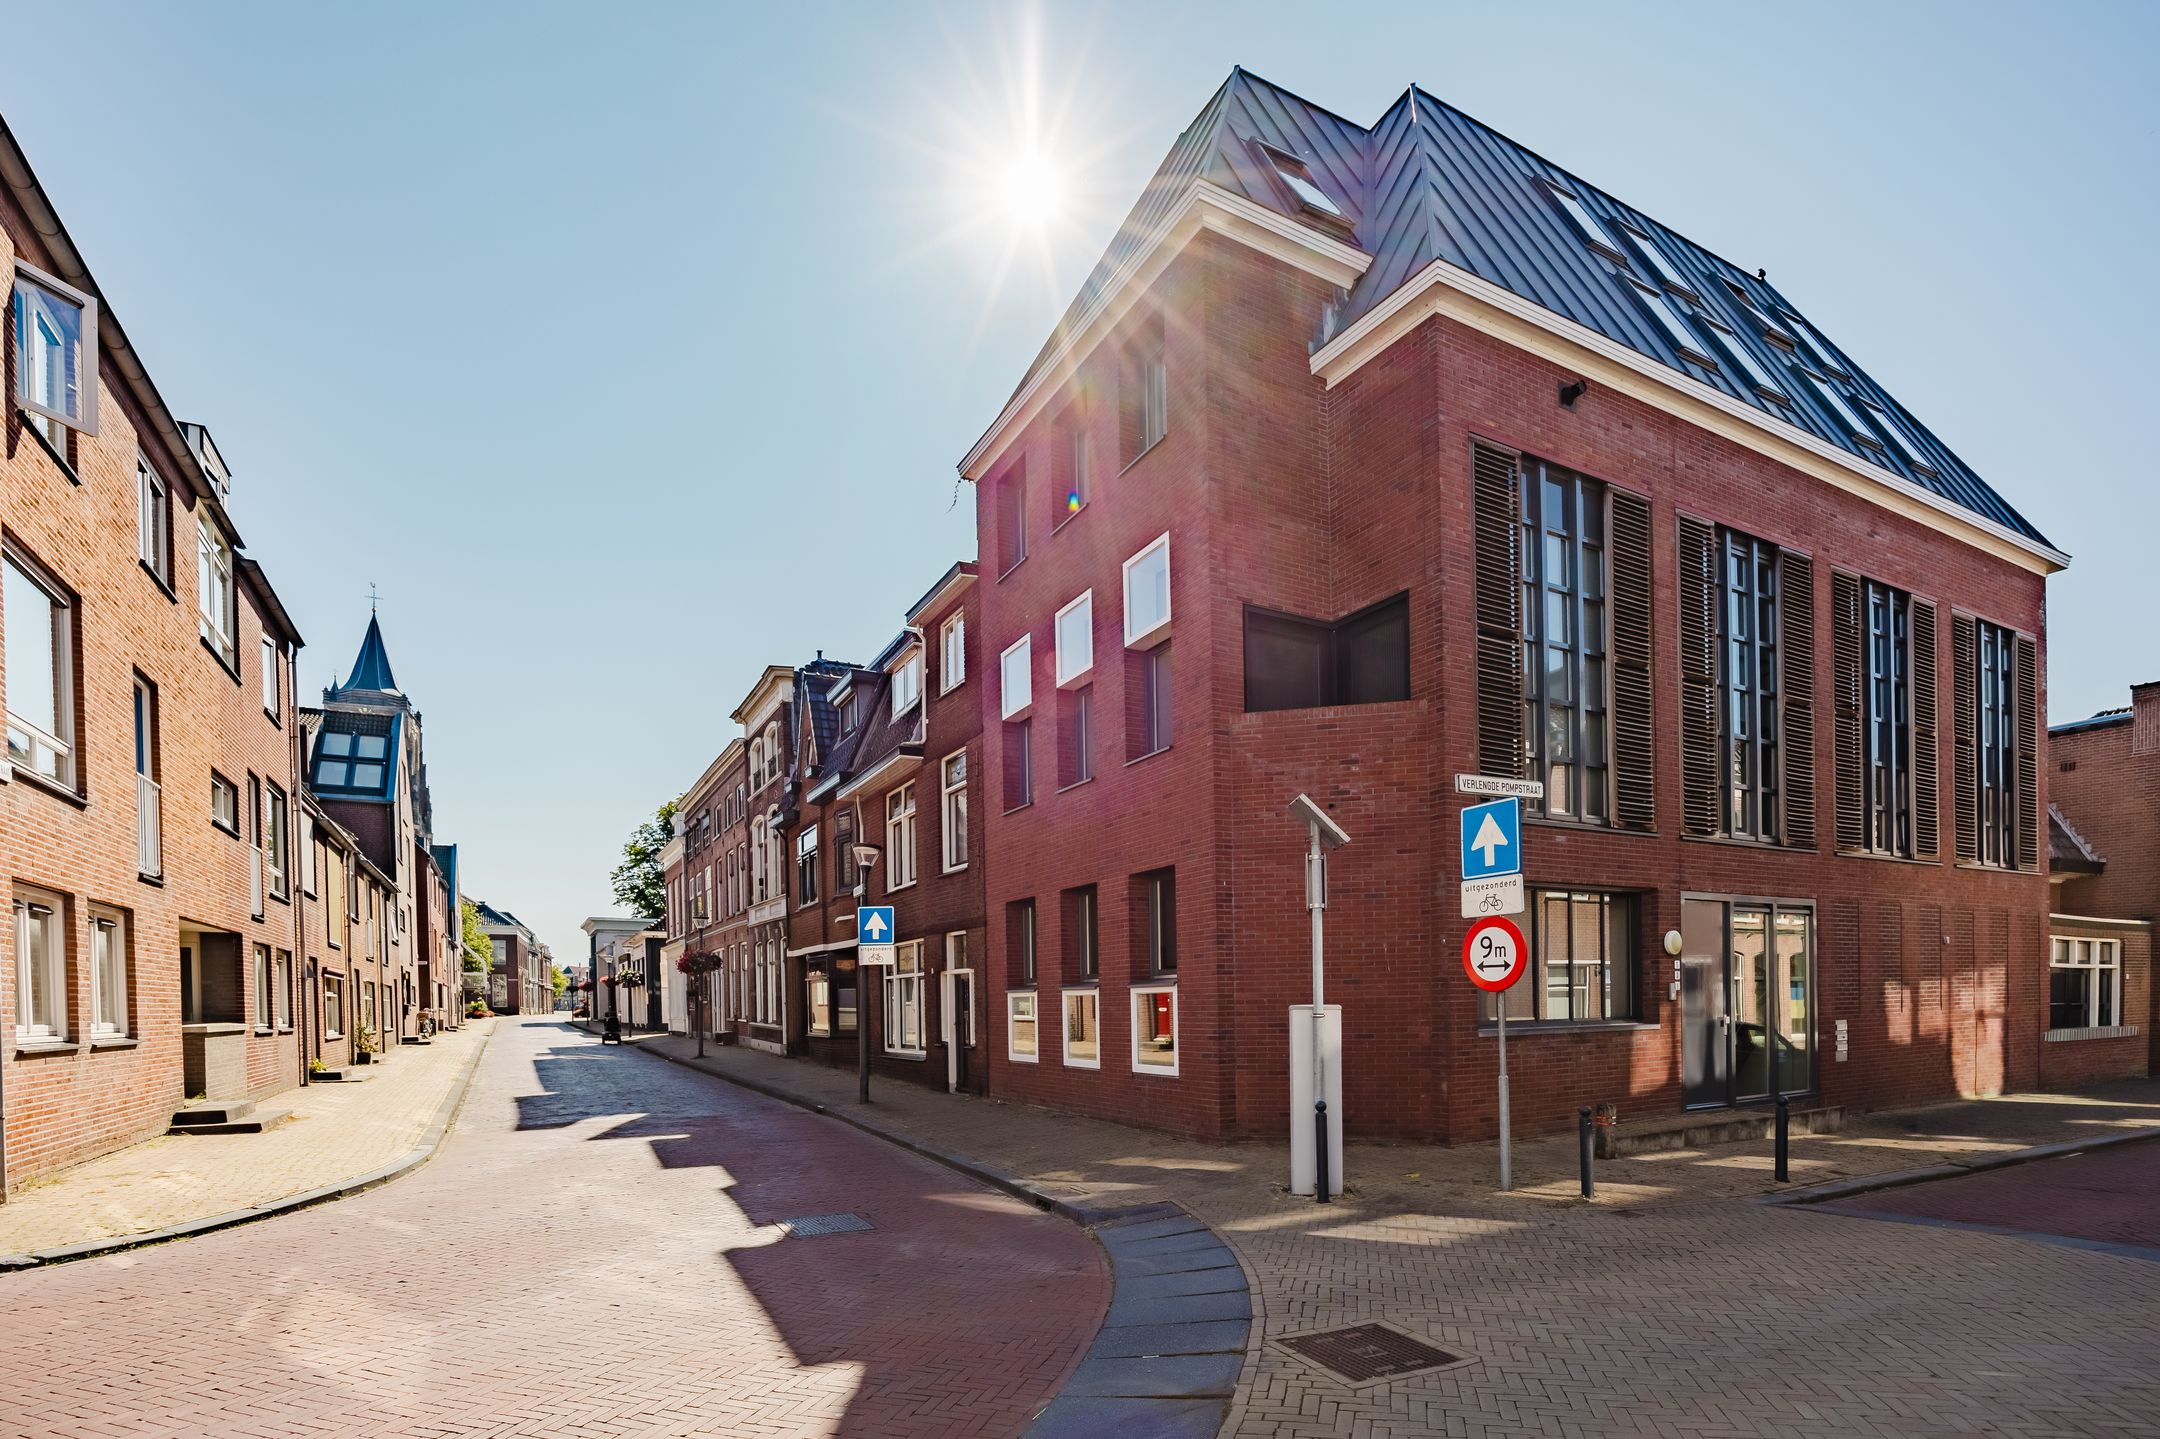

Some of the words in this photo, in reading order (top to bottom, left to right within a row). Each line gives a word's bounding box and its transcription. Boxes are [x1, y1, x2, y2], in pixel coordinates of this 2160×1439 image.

[1462, 778, 1500, 792] VERLENGDE
[1501, 782, 1542, 795] POMPSTRAAT
[1465, 879, 1517, 893] uitgezonderd
